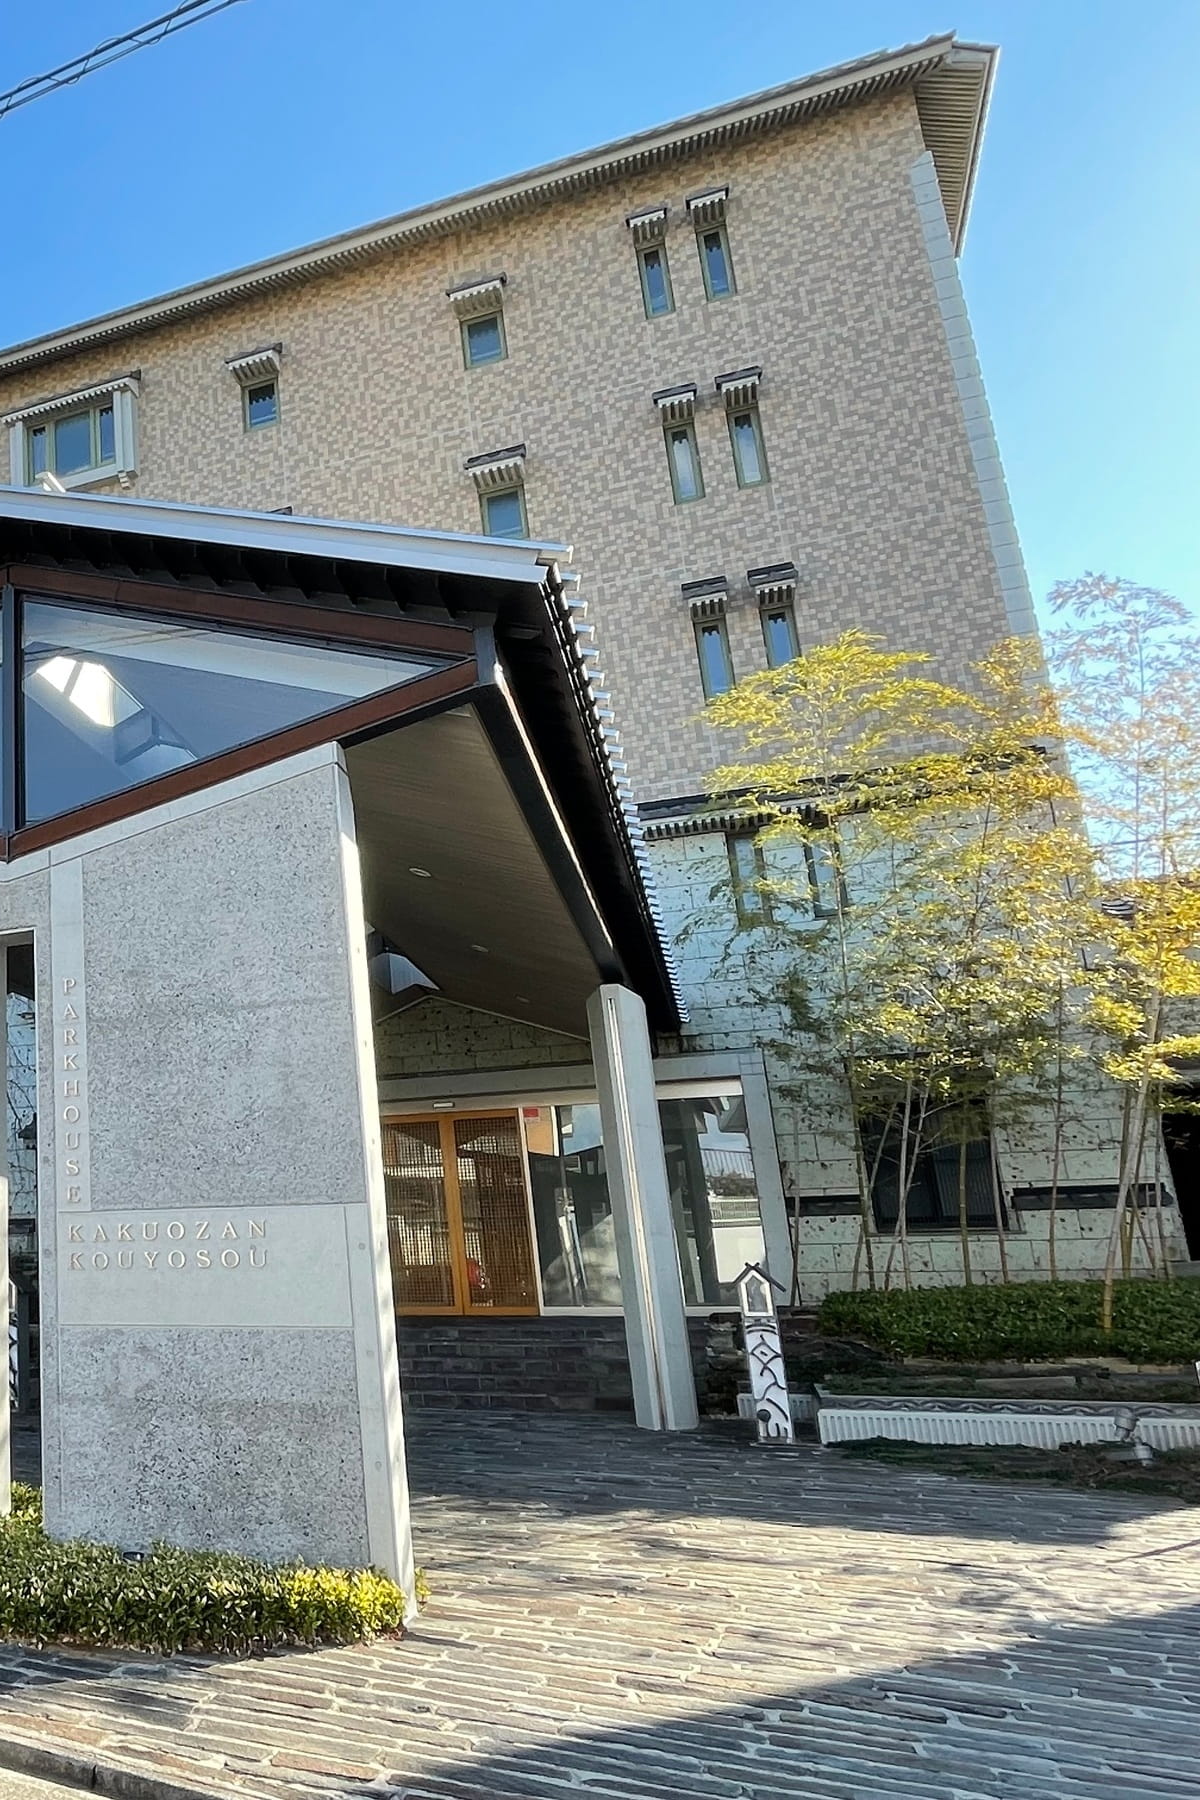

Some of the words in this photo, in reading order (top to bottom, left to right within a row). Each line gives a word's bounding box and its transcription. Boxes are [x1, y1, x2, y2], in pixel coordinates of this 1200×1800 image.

[62, 977, 81, 1203] PARKHOUSE
[68, 1219, 267, 1242] KAKUOZAN
[67, 1247, 268, 1270] KOUYOSOU
